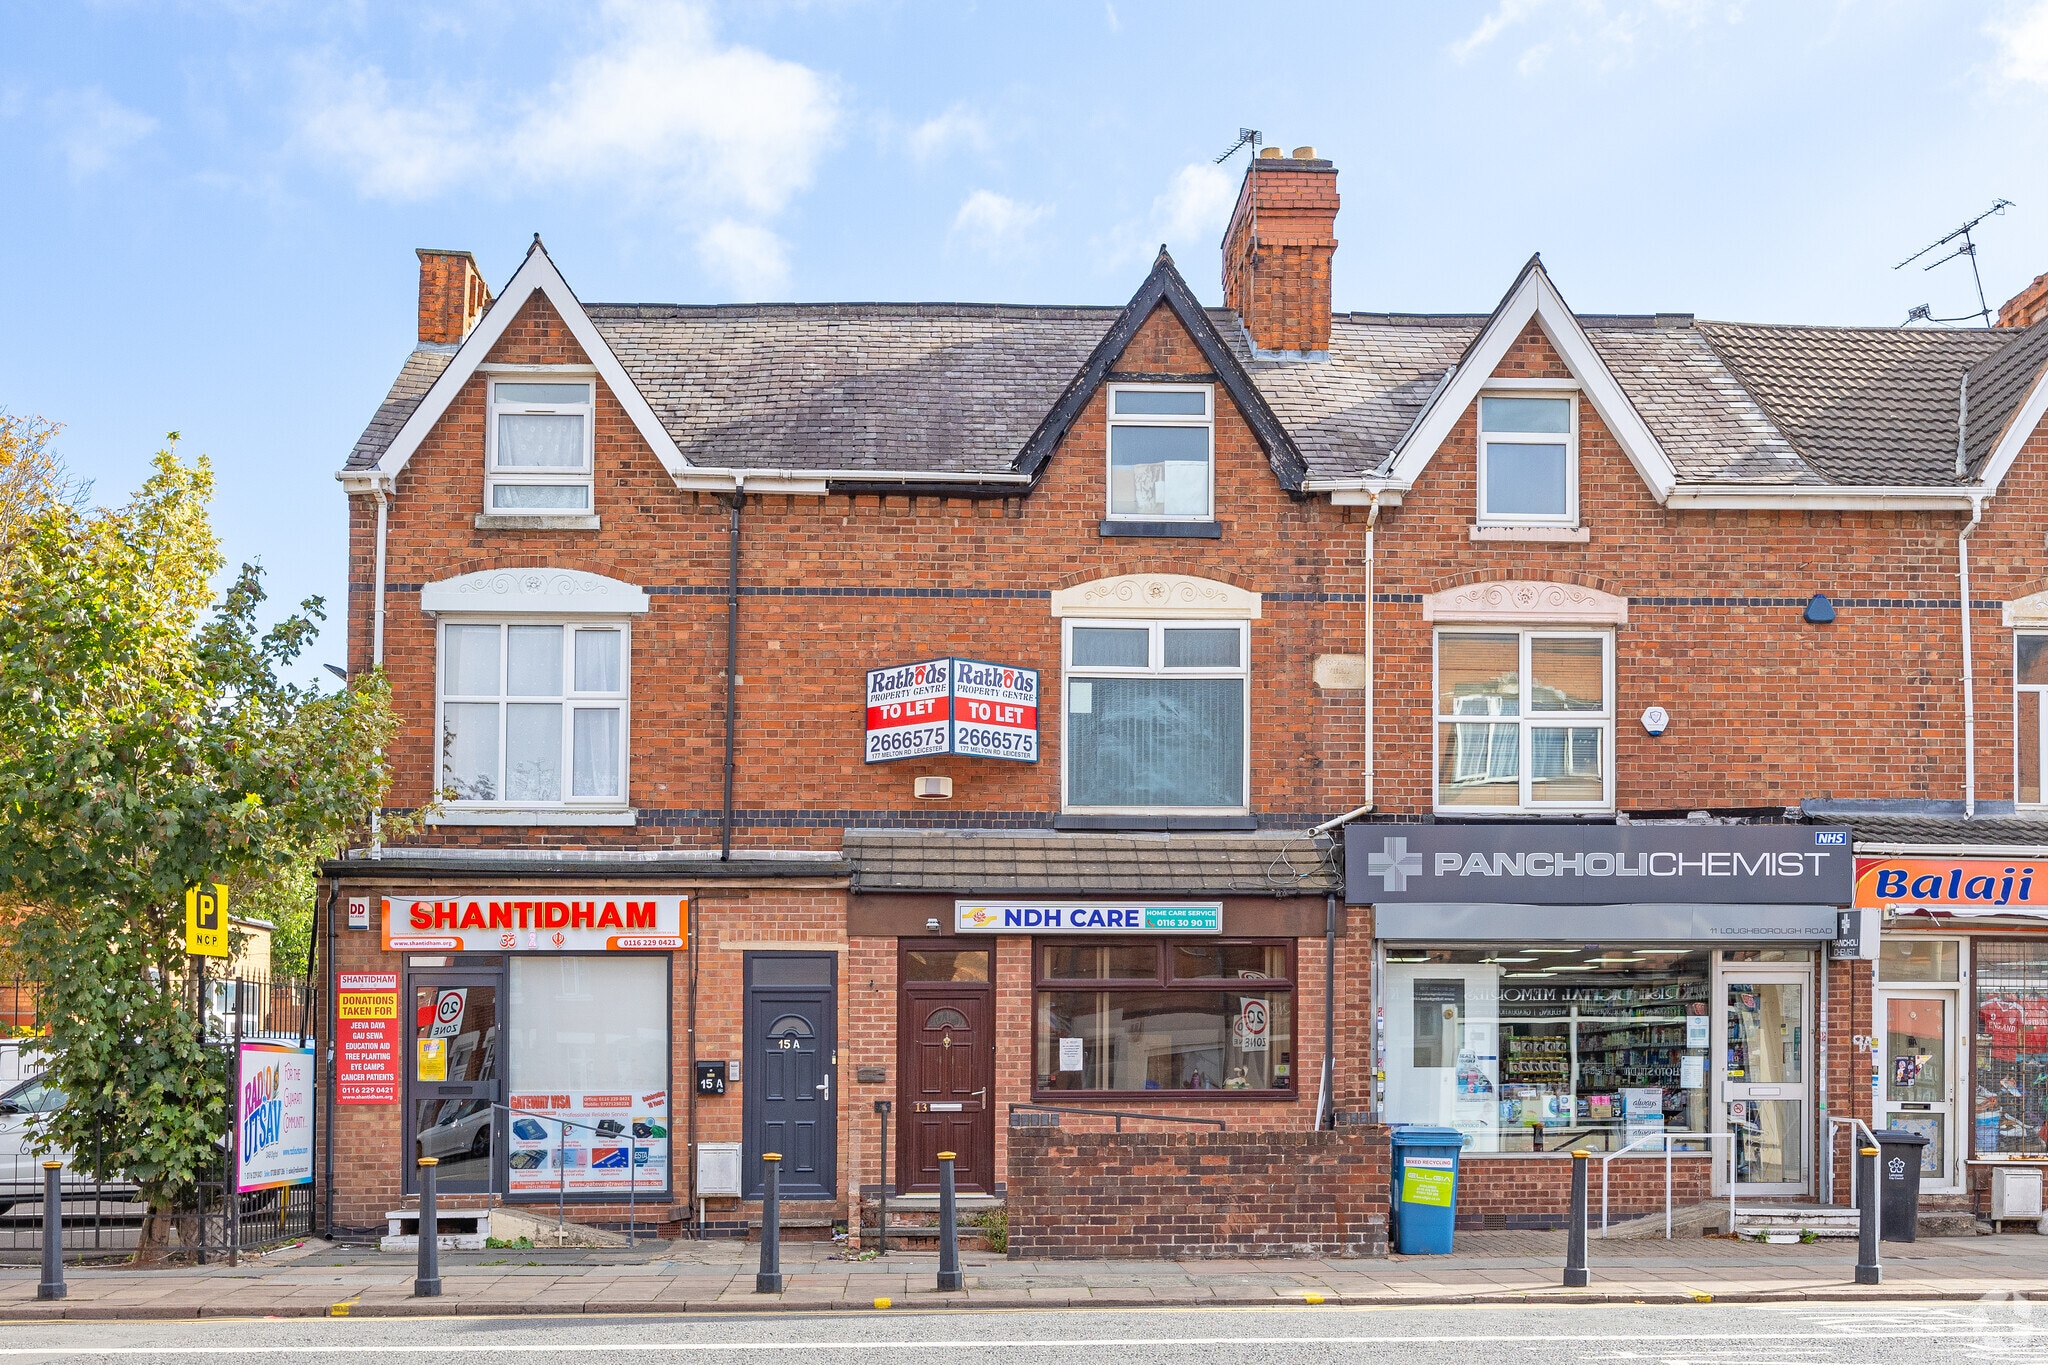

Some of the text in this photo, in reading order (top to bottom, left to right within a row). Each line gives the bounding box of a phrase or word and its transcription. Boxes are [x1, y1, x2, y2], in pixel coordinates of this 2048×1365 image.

[871, 664, 946, 693] Rathods
[957, 663, 1034, 692] Rathods
[870, 684, 946, 702] PROPERTY CENTRE
[957, 684, 1034, 702] PROPERTY CENTRE
[881, 699, 935, 719] TO LET
[968, 702, 1024, 724] TO LET
[871, 727, 945, 753] 2666575
[958, 727, 1033, 752] 2666575
[882, 749, 902, 758] MELTON
[914, 746, 943, 754] LEICESTER
[970, 746, 993, 755] MELTON
[1003, 751, 1031, 759] LEICESTER
[1818, 833, 1844, 843] NHS
[1876, 867, 2034, 906] Balaji
[350, 903, 365, 915] DD
[409, 901, 658, 930] SHANTIDHAM
[1004, 909, 1139, 927] NDH CARE
[1157, 919, 1215, 927] 0116 30 90 111
[196, 934, 218, 946] NCP
[1832, 939, 1858, 947] PANCHOLI
[342, 975, 395, 984] SHANTIDHAM
[342, 996, 394, 1005] DONATIONS
[343, 1007, 392, 1015] TAKEN FOR
[1988, 1021, 2016, 1033] ENGLAND
[779, 1040, 800, 1049] 15 A
[366, 1073, 394, 1081] PATIENTS
[700, 1079, 723, 1089] 15 A
[244, 1066, 272, 1120] RADIO
[510, 1095, 571, 1109] GATEWAY VISA
[915, 1103, 928, 1112] 13
[1632, 1097, 1657, 1108] always
[244, 1099, 282, 1165] UTSAV
